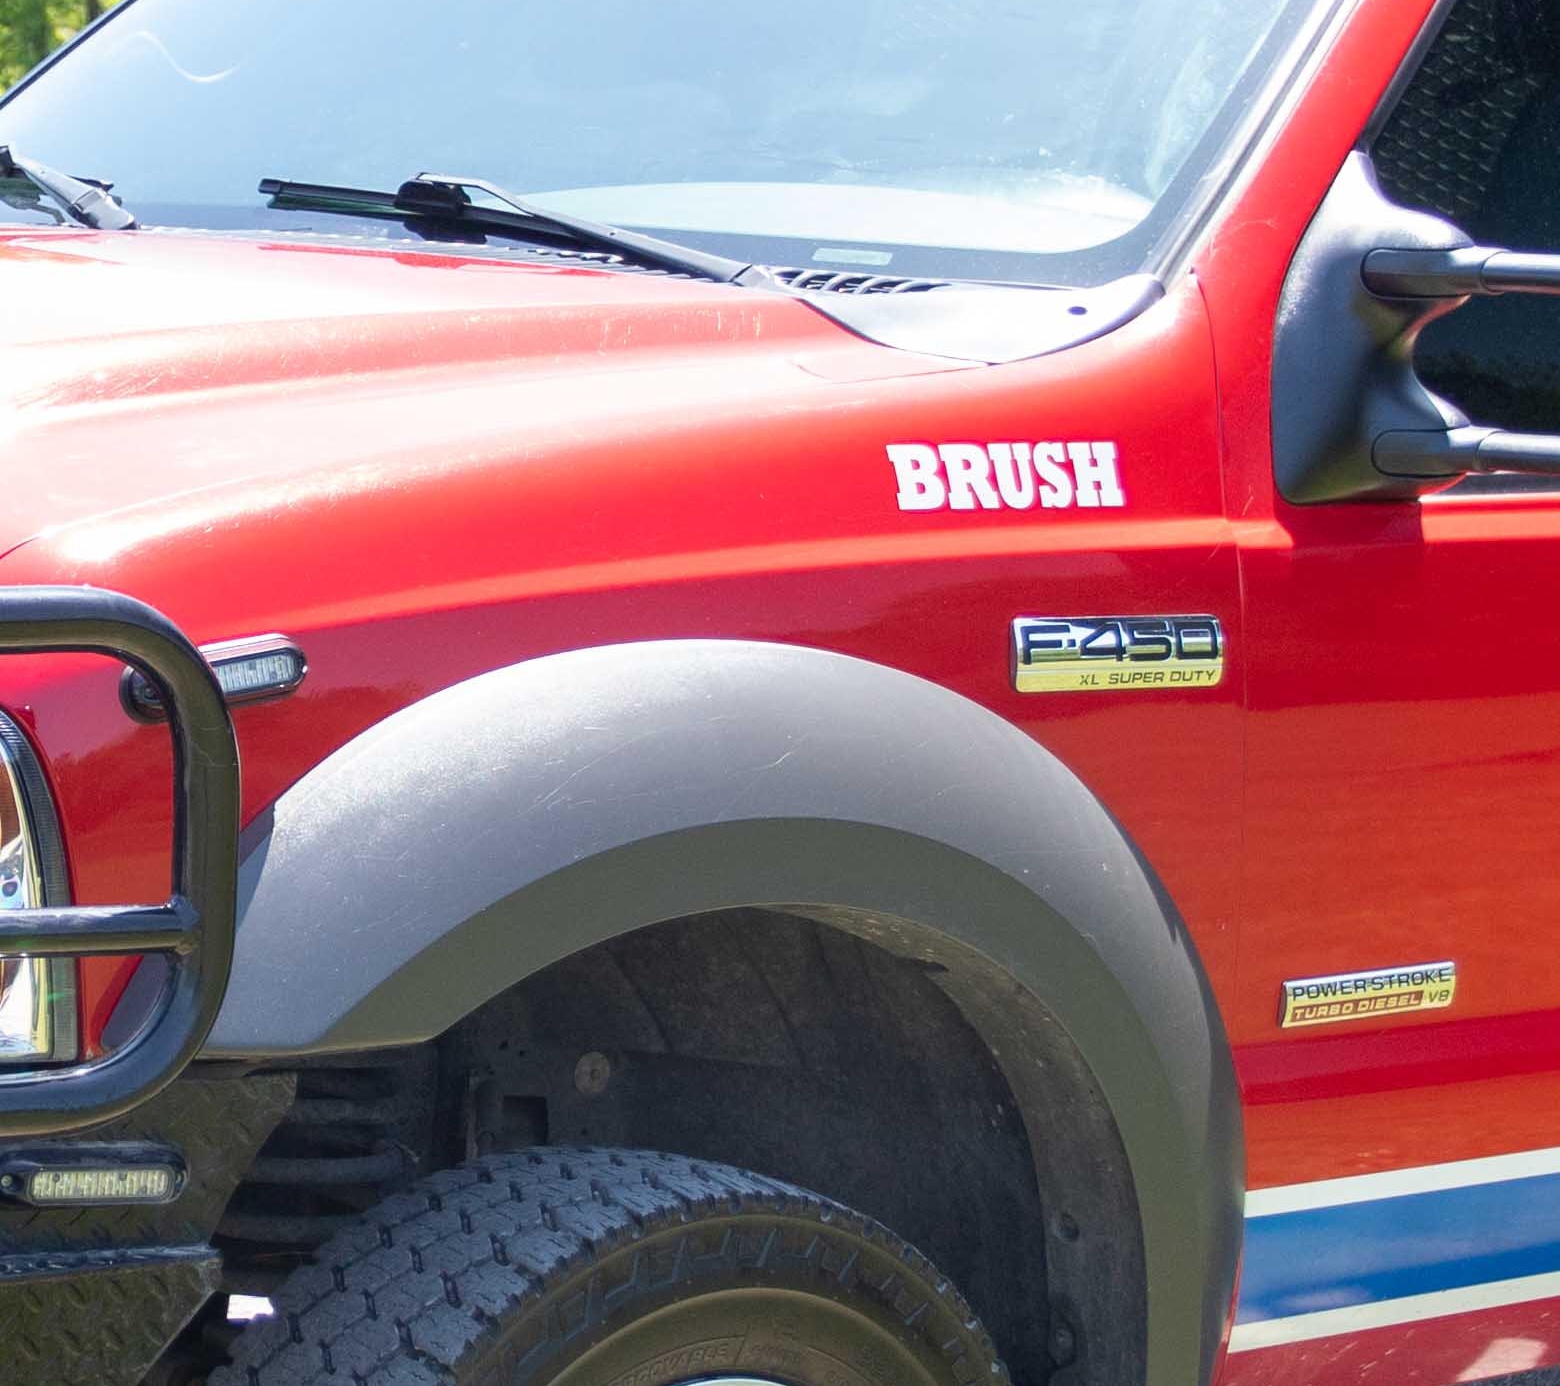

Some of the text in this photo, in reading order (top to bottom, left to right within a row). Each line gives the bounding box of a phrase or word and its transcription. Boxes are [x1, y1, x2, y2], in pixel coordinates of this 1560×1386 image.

[886, 441, 1124, 510] BRUSH
[1020, 621, 1219, 665] F-450
[1079, 669, 1216, 685] XL SUPER DUTY
[1295, 989, 1450, 1020] TURBO DIESEL V8
